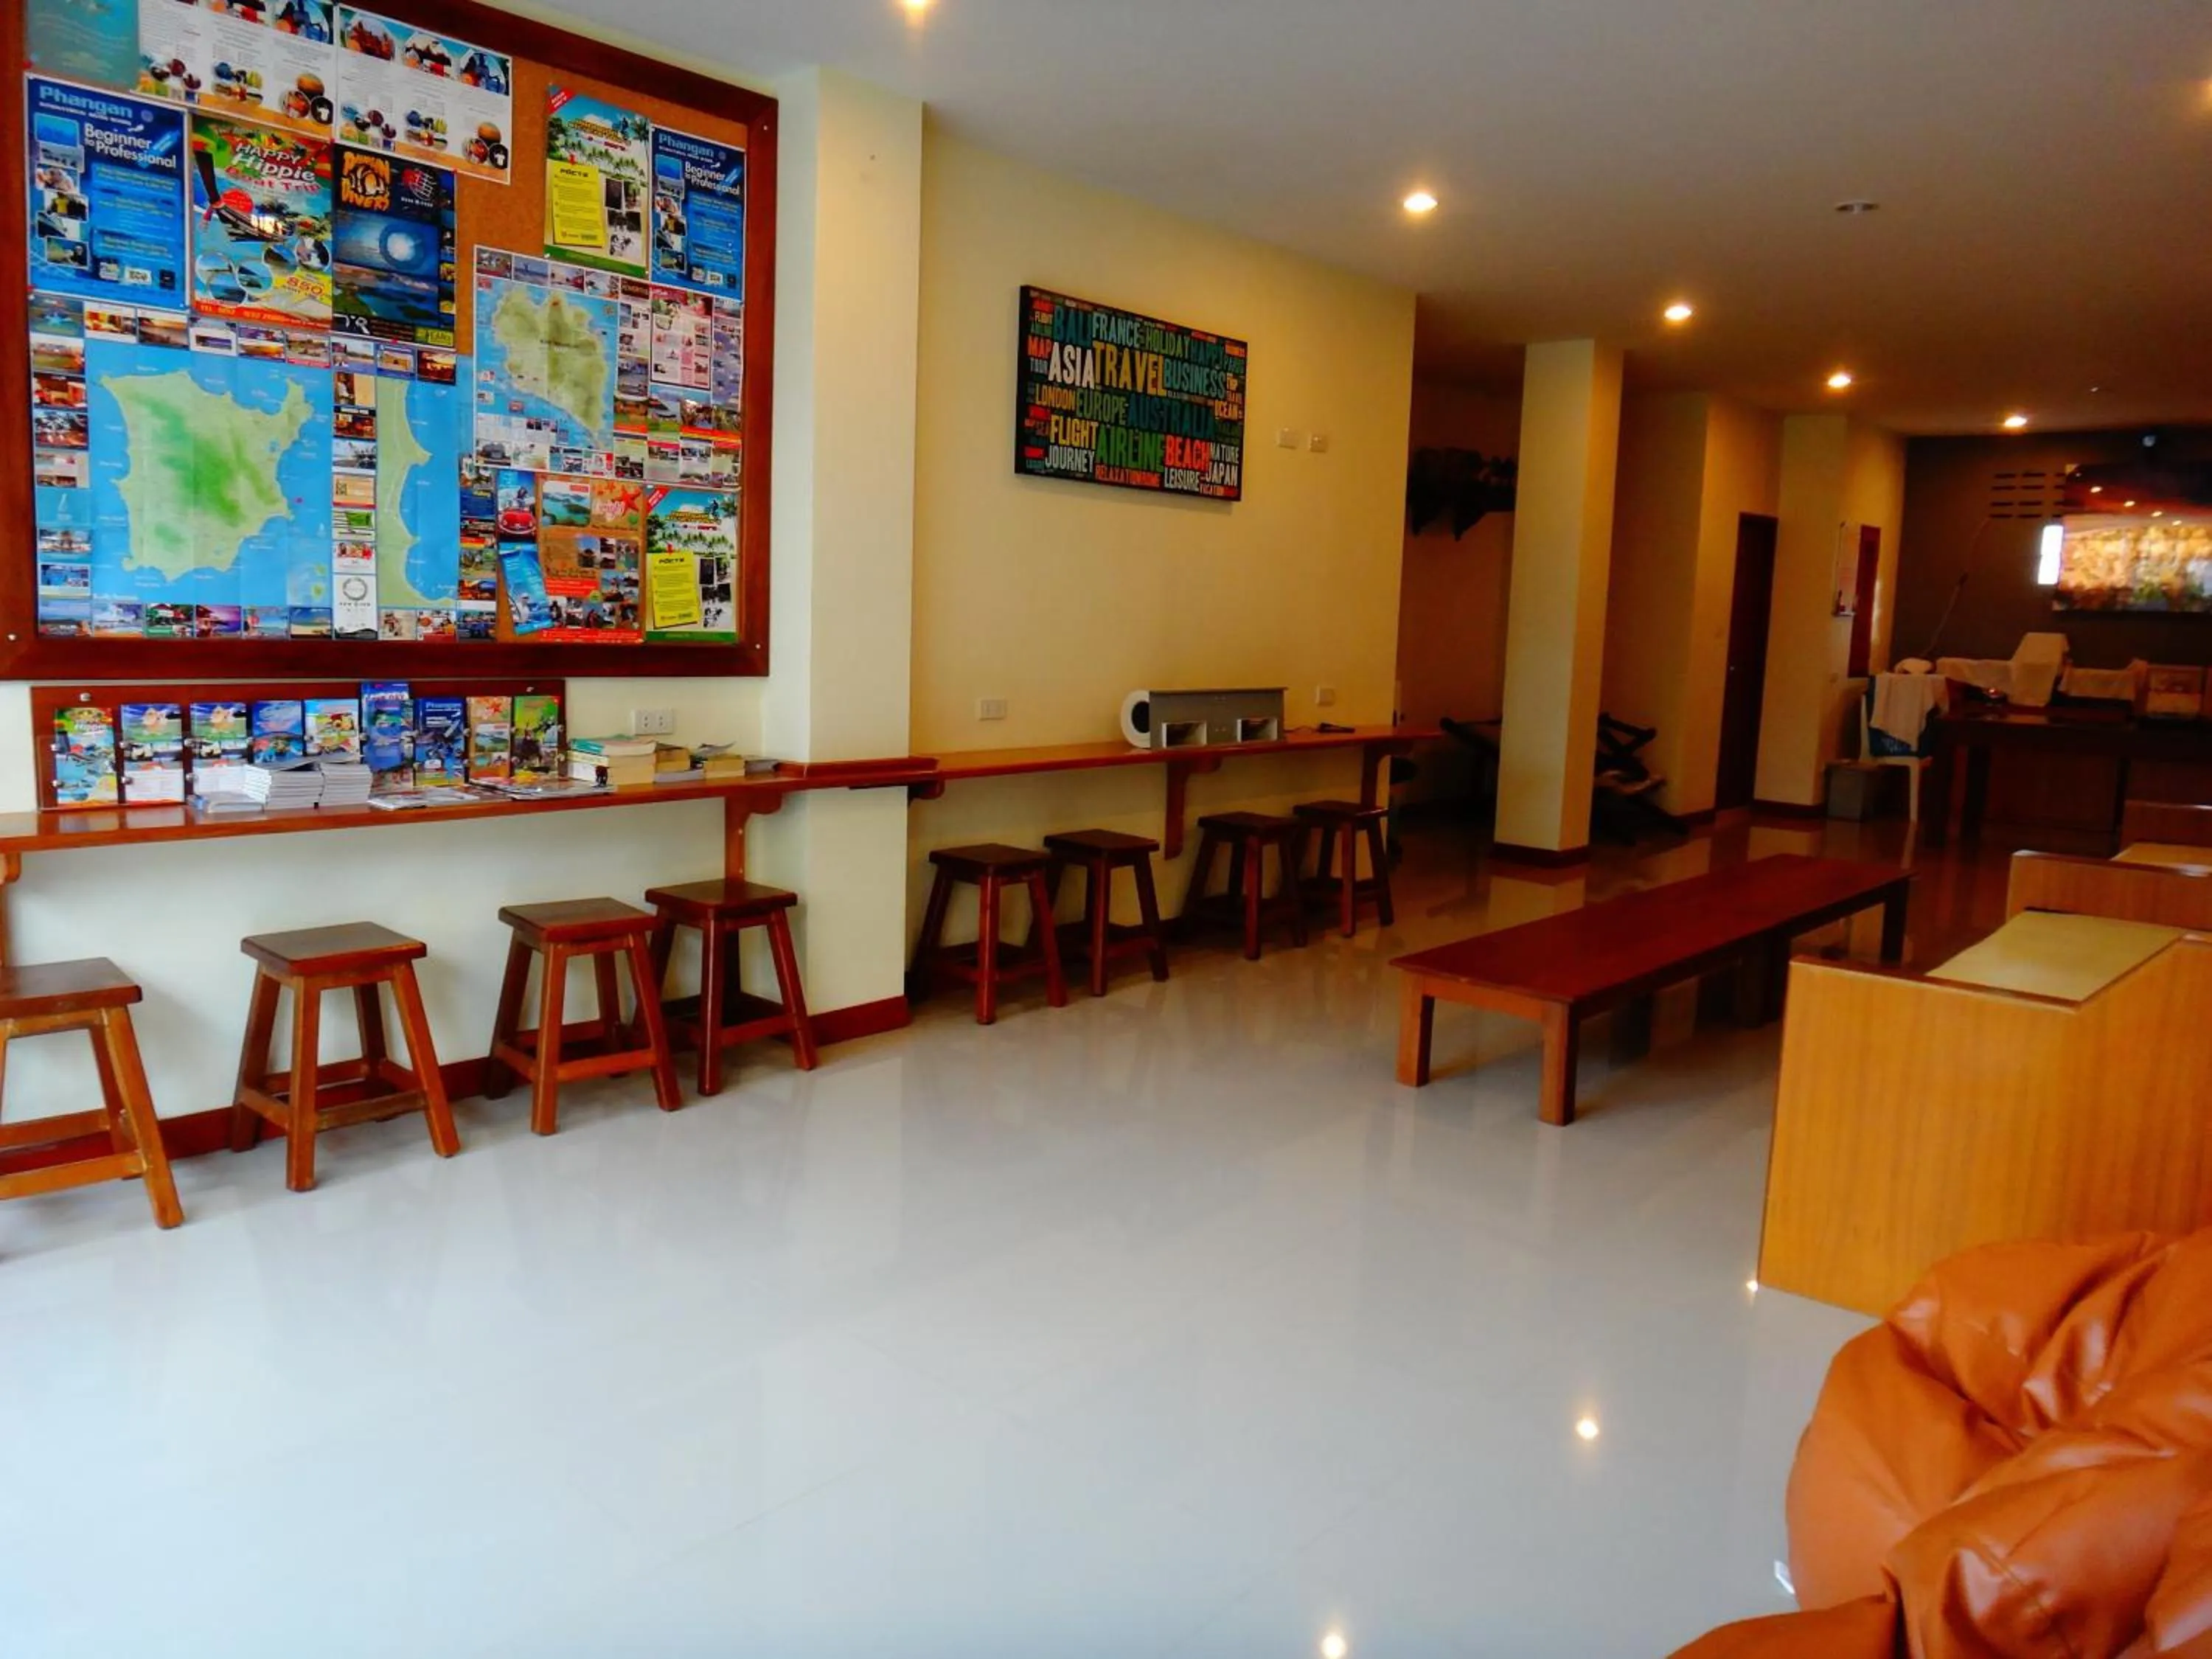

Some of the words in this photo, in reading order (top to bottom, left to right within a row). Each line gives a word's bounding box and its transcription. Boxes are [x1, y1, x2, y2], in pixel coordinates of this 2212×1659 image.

[39, 86, 133, 118] Phangan
[84, 122, 153, 150] Beginner
[658, 133, 714, 158] Phangan
[85, 138, 95, 147] to
[97, 139, 177, 169] Professional
[231, 152, 316, 181] Hippie
[235, 143, 301, 164] HAPPY
[685, 161, 726, 181] Beginner
[691, 175, 740, 195] Professional
[1054, 305, 1093, 348] BALI
[1093, 312, 1141, 349] FRANCE
[1146, 327, 1191, 360] HOLIDAY
[1028, 335, 1052, 359] MAP
[1048, 341, 1095, 389] ASIA
[1092, 340, 1166, 397] TRAVEL
[1163, 358, 1225, 399] BUSINESS
[1036, 383, 1076, 411] LONDON
[1076, 388, 1127, 426] EUROPE
[1127, 394, 1215, 443] AUSTRALIA
[1214, 399, 1239, 421] OCEAN
[1050, 414, 1099, 451] FLIGHT
[1094, 423, 1164, 473] AIRLINE
[1164, 435, 1209, 473] BEACH
[1209, 442, 1239, 465] NATURE
[1045, 445, 1095, 473] JOURNEY
[1206, 461, 1239, 487] JAPAN
[1164, 466, 1201, 492] LEISURE
